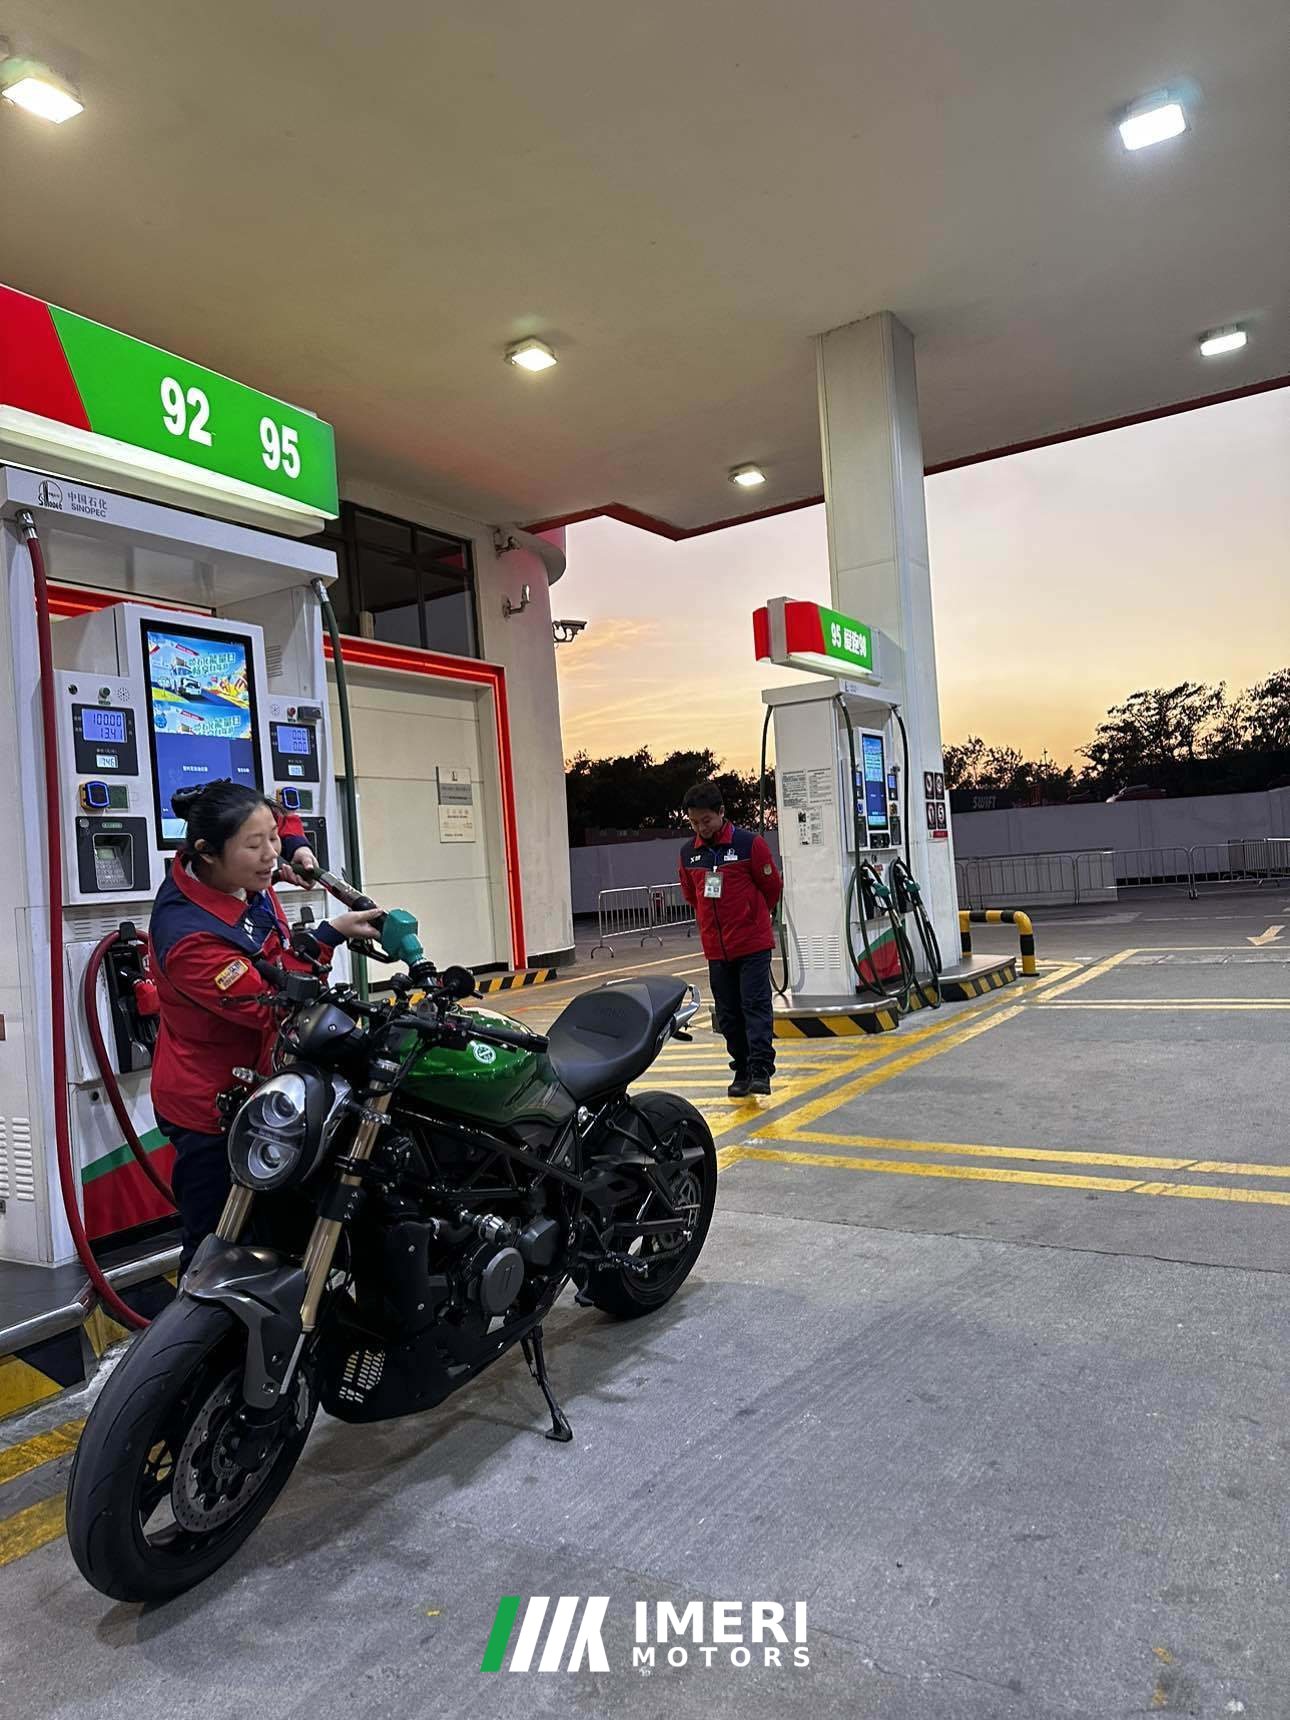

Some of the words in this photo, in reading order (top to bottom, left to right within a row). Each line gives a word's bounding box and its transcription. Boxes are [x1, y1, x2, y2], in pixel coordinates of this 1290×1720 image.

[160, 376, 212, 447] 92
[259, 417, 302, 479] 95
[68, 491, 108, 510] 中国石化
[71, 503, 107, 518] SINOPEC
[831, 622, 842, 648] 95
